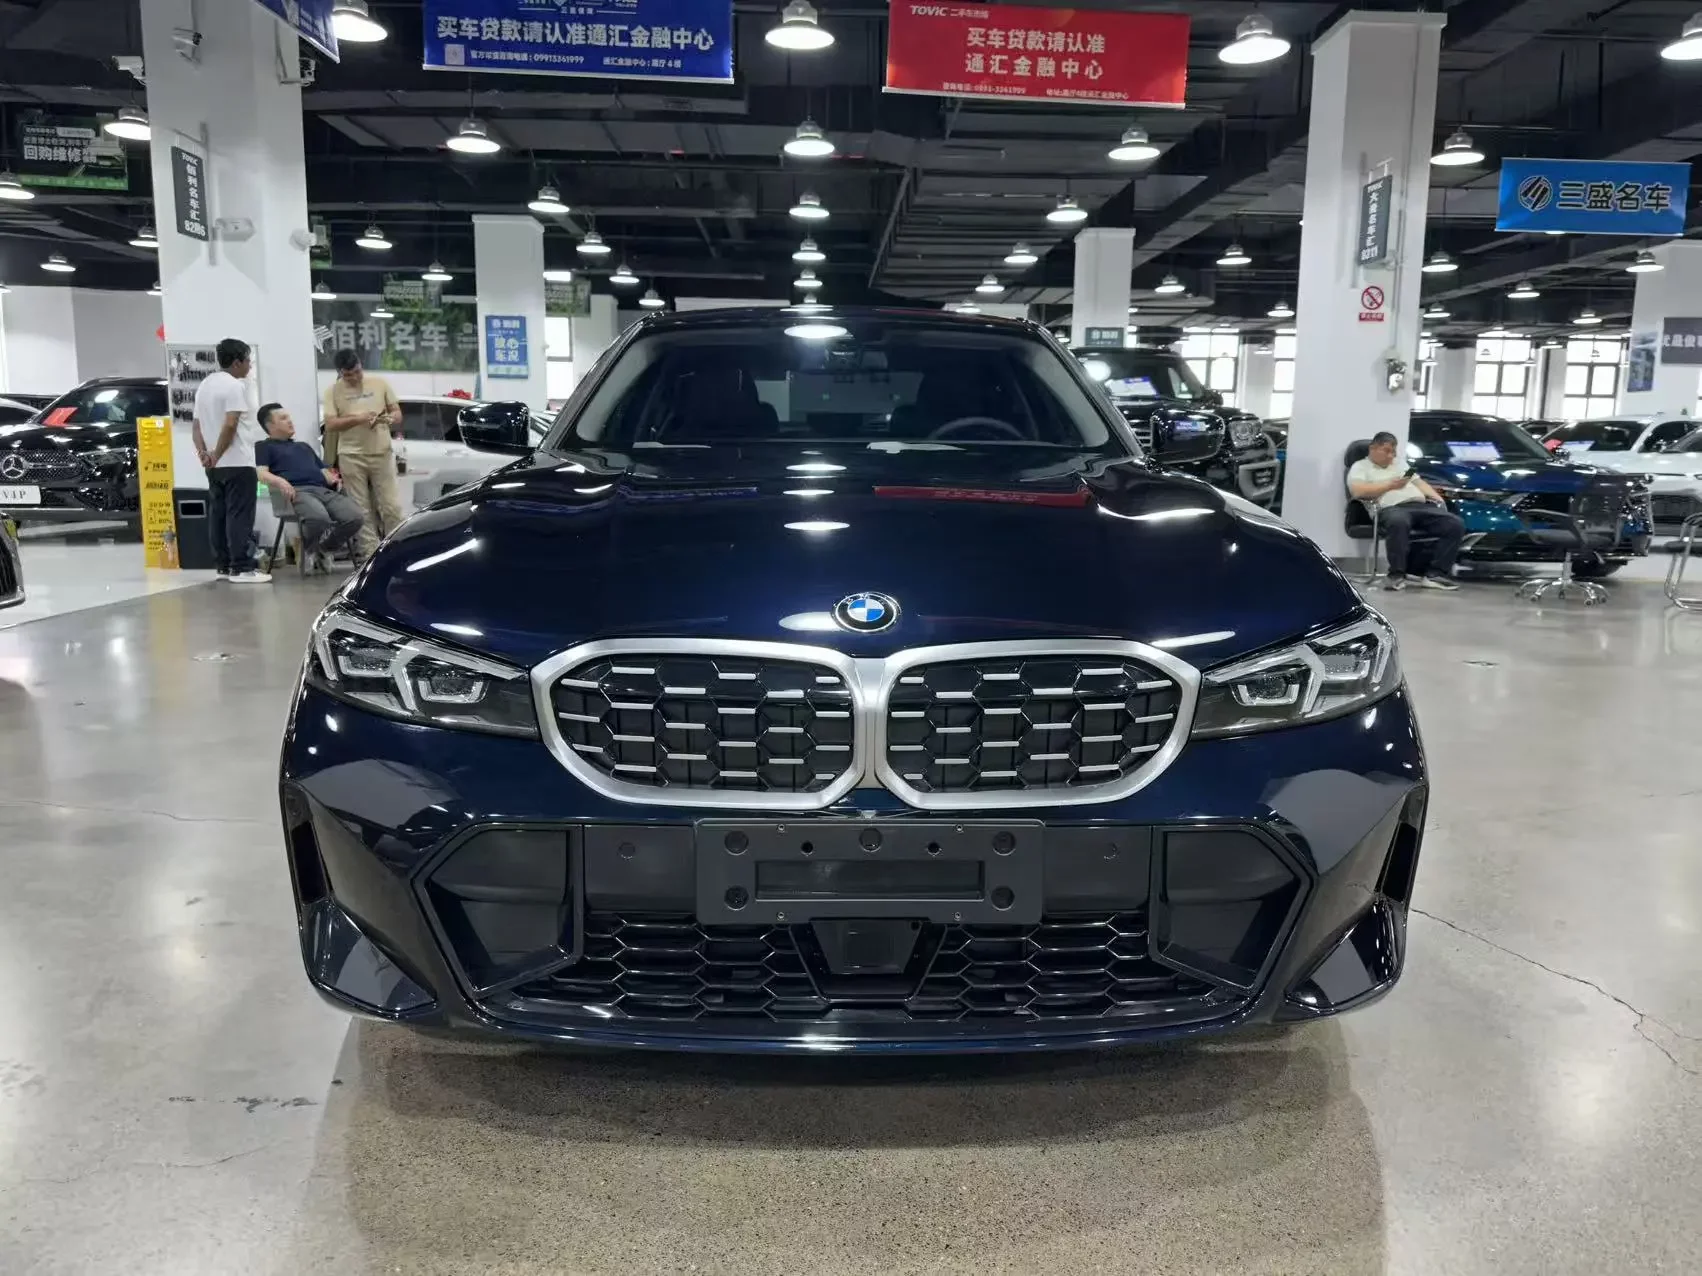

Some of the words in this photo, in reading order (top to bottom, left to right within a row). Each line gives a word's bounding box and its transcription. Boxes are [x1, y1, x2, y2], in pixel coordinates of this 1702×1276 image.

[910, 5, 948, 17] TOVIC
[437, 15, 715, 51] 买车贷款请认准通汇金融中心
[966, 26, 1106, 54] 买车贷款请认准
[965, 53, 1104, 80] 通汇金融中心
[186, 164, 200, 221] 佰利名车汇
[1555, 180, 1673, 213] 三盛名车
[331, 319, 450, 353] 佰利名车
[2, 490, 27, 499] VIP
